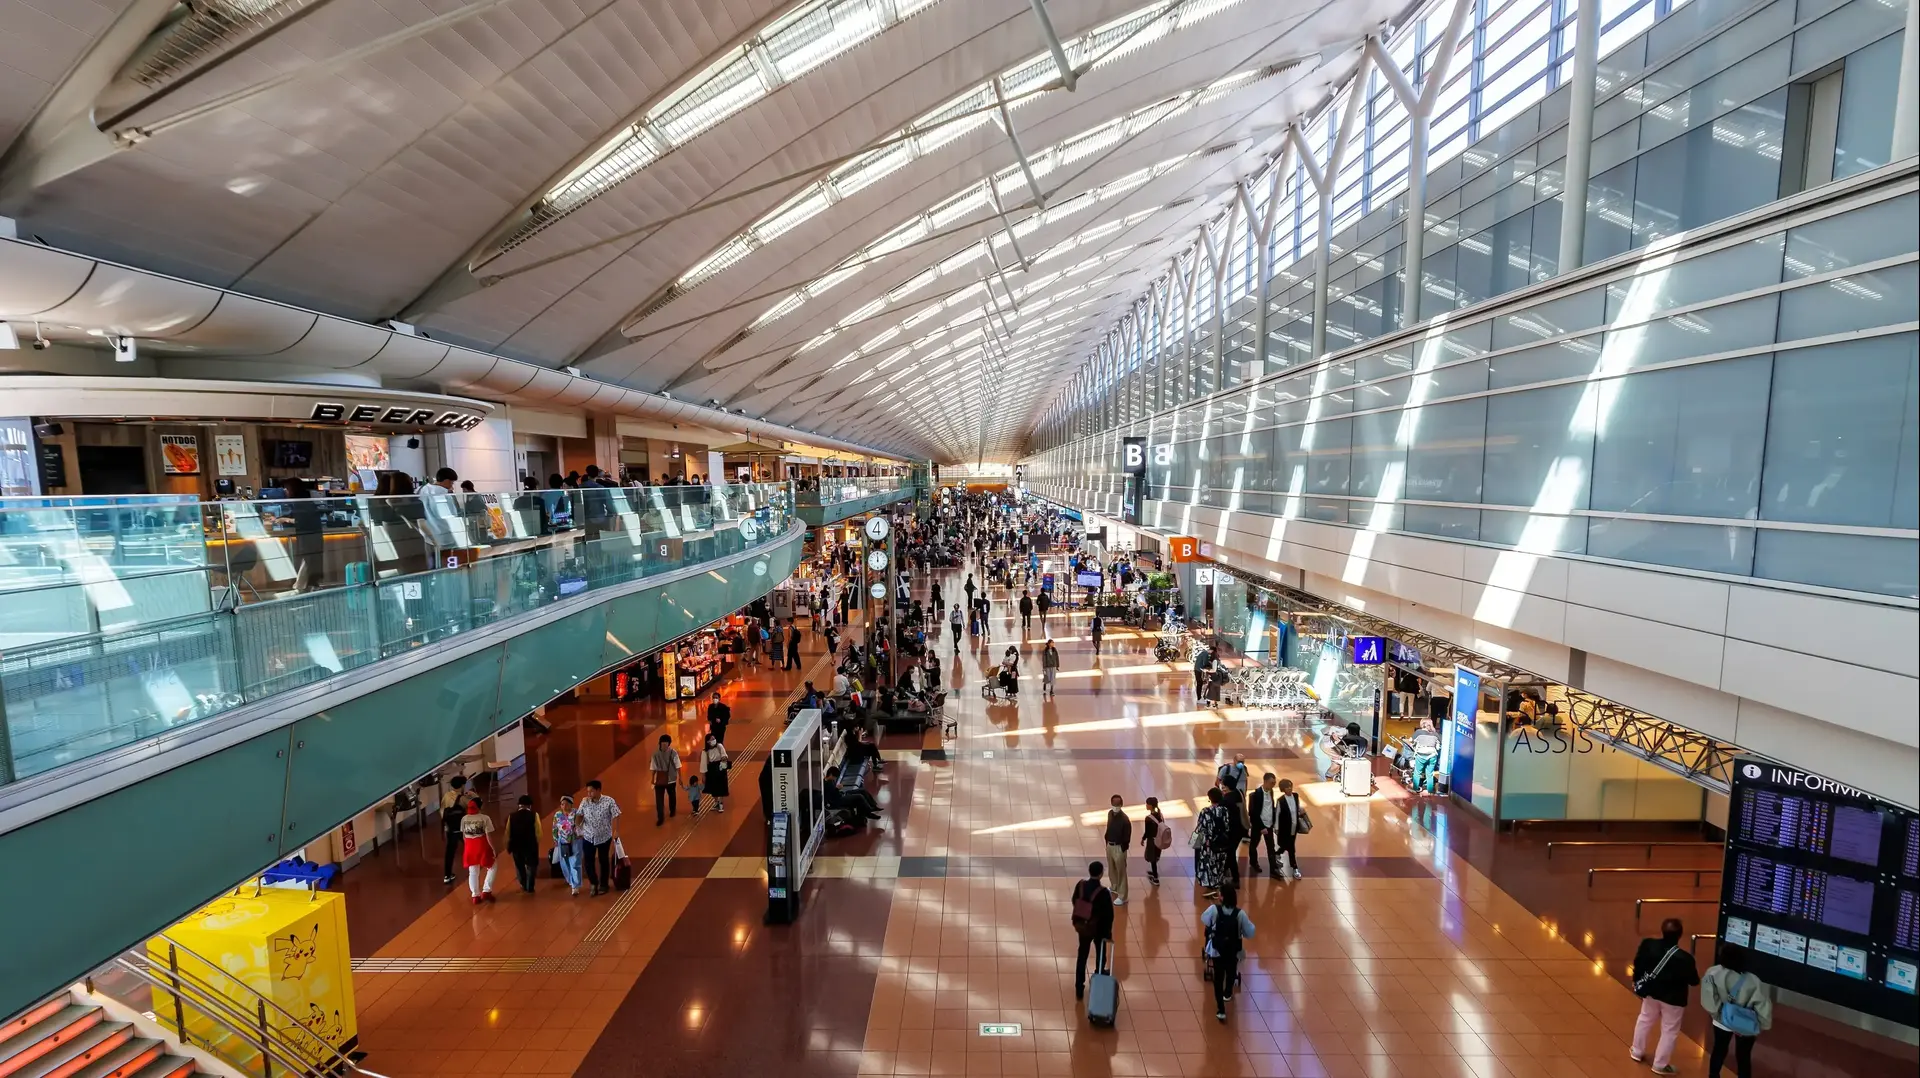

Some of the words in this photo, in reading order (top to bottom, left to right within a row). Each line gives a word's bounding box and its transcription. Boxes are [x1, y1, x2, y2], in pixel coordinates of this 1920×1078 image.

[311, 402, 435, 425] BEER
[162, 436, 195, 445] HOTDOG
[1126, 444, 1143, 466] B
[872, 521, 881, 536] 4
[1182, 543, 1192, 557] B
